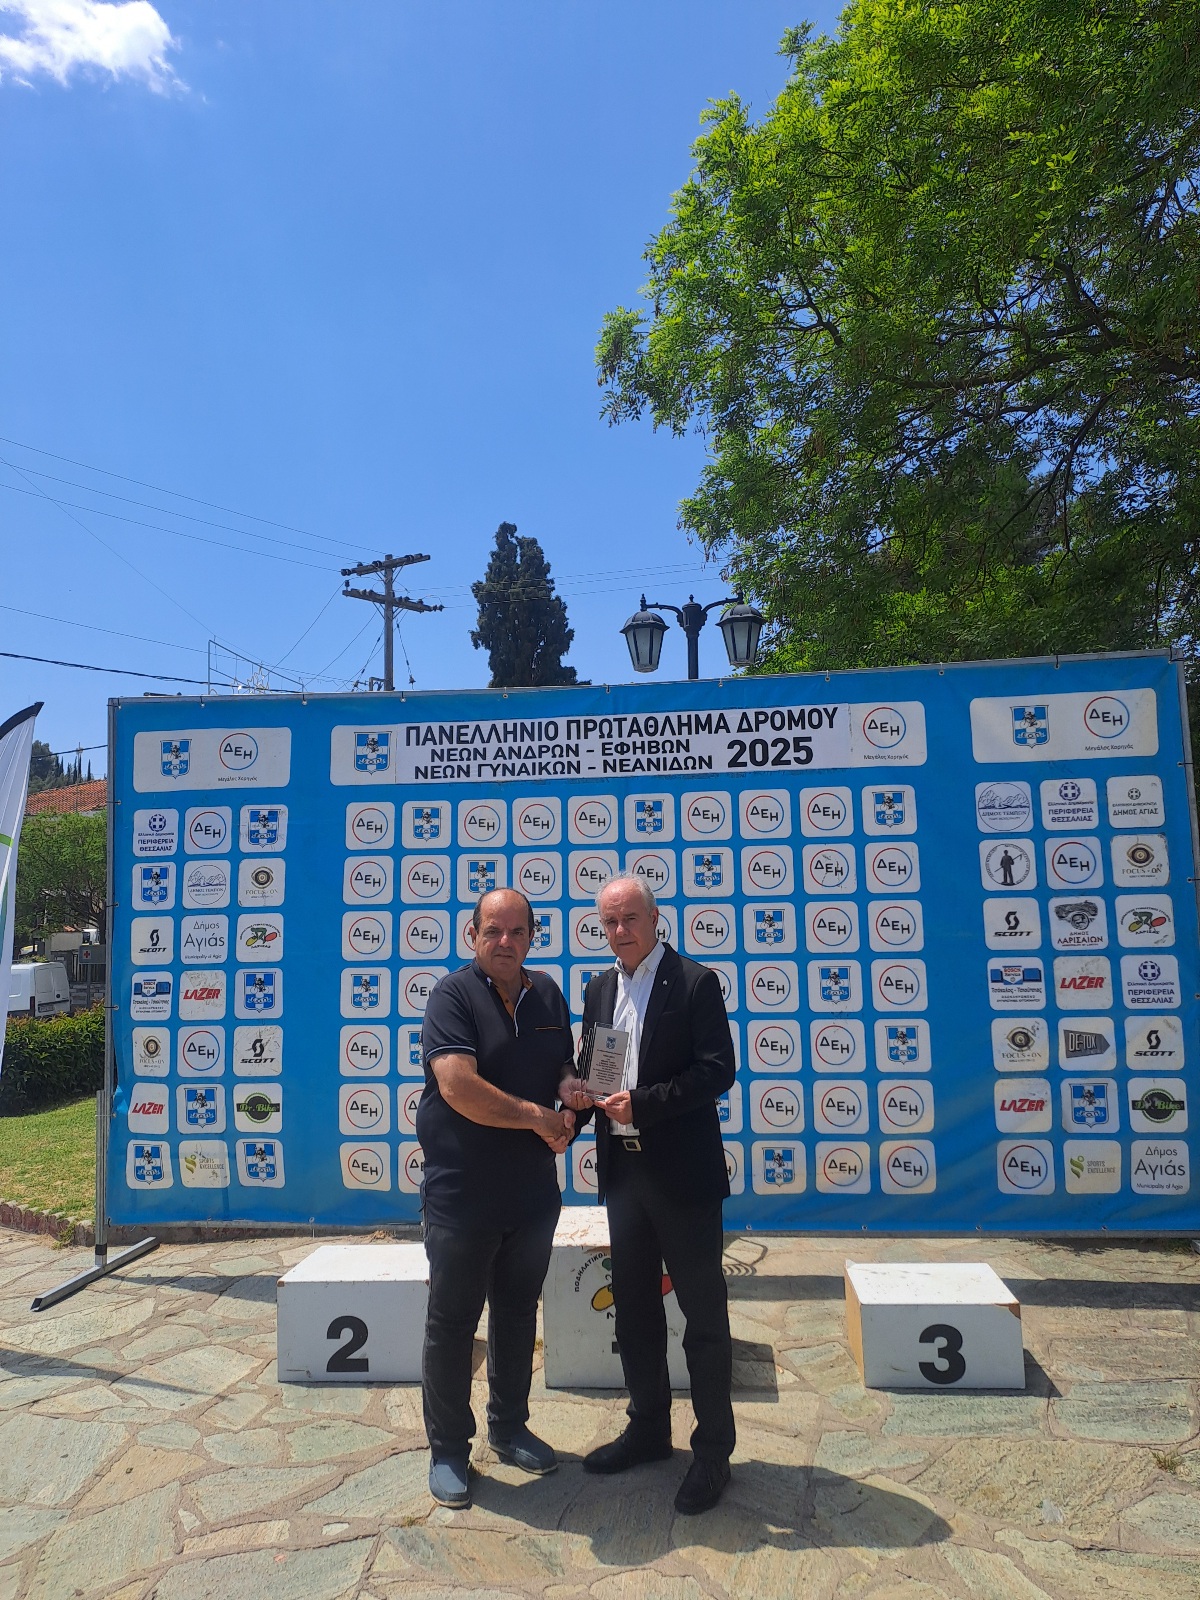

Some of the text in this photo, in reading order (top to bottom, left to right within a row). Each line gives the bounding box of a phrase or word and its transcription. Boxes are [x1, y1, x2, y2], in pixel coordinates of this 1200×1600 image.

[1089, 709, 1122, 726] ΔΕΗ
[405, 706, 839, 746] ΠΑΝΕΛΛΗΝΙΟ ΠΡΩΤΑΘΛΗΜΑ ΔΡΟΜΟΥ
[867, 719, 900, 736] ΔΕΗ
[223, 742, 253, 760] ΔΕΗ
[430, 746, 487, 763] ΝΕΩΝ
[493, 743, 580, 761] ΑΝΔΡΩΝ
[601, 738, 691, 757] ΕΦΗΒΩΝ
[727, 736, 814, 768] 2025
[414, 764, 471, 780] ΝΕΩΝ
[477, 760, 581, 778] ΓΥΝΑΙΚΩΝ
[602, 754, 713, 774] ΝΕΑΝΙΔΩΝ
[578, 811, 606, 827] ΔΕΗ
[691, 807, 720, 823] ΔΕΗ
[750, 806, 778, 821] ΔΕΗ
[811, 804, 841, 820] ΔΕΗ
[1139, 807, 1159, 815] ΑΓΙΑΣ
[194, 822, 221, 838] ΔΕΗ
[356, 818, 383, 834] ΔΕΗ
[468, 816, 494, 831] ΔΕΗ
[524, 815, 549, 829] ΔΕΗ
[752, 862, 781, 878] ΔΕΗ
[814, 860, 844, 876] ΔΕΗ
[877, 859, 906, 874] ΔΕΗ
[1057, 854, 1089, 871] ΔΕΗ
[354, 871, 381, 887] ΔΕΗ
[412, 872, 438, 887] ΔΕΗ
[524, 869, 549, 884] ΔΕΗ
[637, 866, 663, 881] ΔΕΗ
[193, 920, 221, 932] Δήμος
[696, 921, 723, 936] ΔΕΗ
[817, 919, 846, 934] ΔΕΗ
[881, 918, 910, 934] ΔΕΗ
[993, 930, 1034, 938] SCOTT
[183, 932, 225, 952] Αγιάς
[352, 927, 380, 943] ΔΕΗ
[410, 926, 438, 943] ΔΕΗ
[1057, 936, 1104, 944] ΛΑΡΙΣΑΙΩΝ
[409, 983, 432, 997] ΔΕ
[756, 978, 784, 994] ΔΕΗ
[884, 977, 913, 993] ΔΕΗ
[1060, 975, 1105, 990] LAZER
[183, 987, 221, 1001] LAZER
[350, 1042, 377, 1058] ΔΕΗ
[760, 1038, 788, 1054] ΔΕΗ
[820, 1037, 849, 1053] ΔΕΗ
[1069, 1033, 1097, 1051] DE-TOX
[187, 1042, 214, 1059] ΔΕΗ
[132, 1101, 164, 1115] LAZER
[256, 1103, 277, 1112] Bike
[350, 1101, 377, 1117] ΔΕΗ
[765, 1098, 793, 1115] ΔΕΗ
[826, 1098, 855, 1115] ΔΕΗ
[888, 1098, 918, 1115] ΔΕΗ
[1000, 1098, 1045, 1113] LAZER
[1145, 1146, 1178, 1159] Δήμος
[352, 1159, 378, 1175] ΔΕΗ
[828, 1159, 856, 1175] ΔΕΗ
[892, 1158, 922, 1176] ΔΕΗ
[1007, 1156, 1042, 1177] ΔΕΗ
[1134, 1159, 1186, 1180] Αγιάς
[326, 1315, 369, 1373] 2
[918, 1323, 966, 1385] 3
